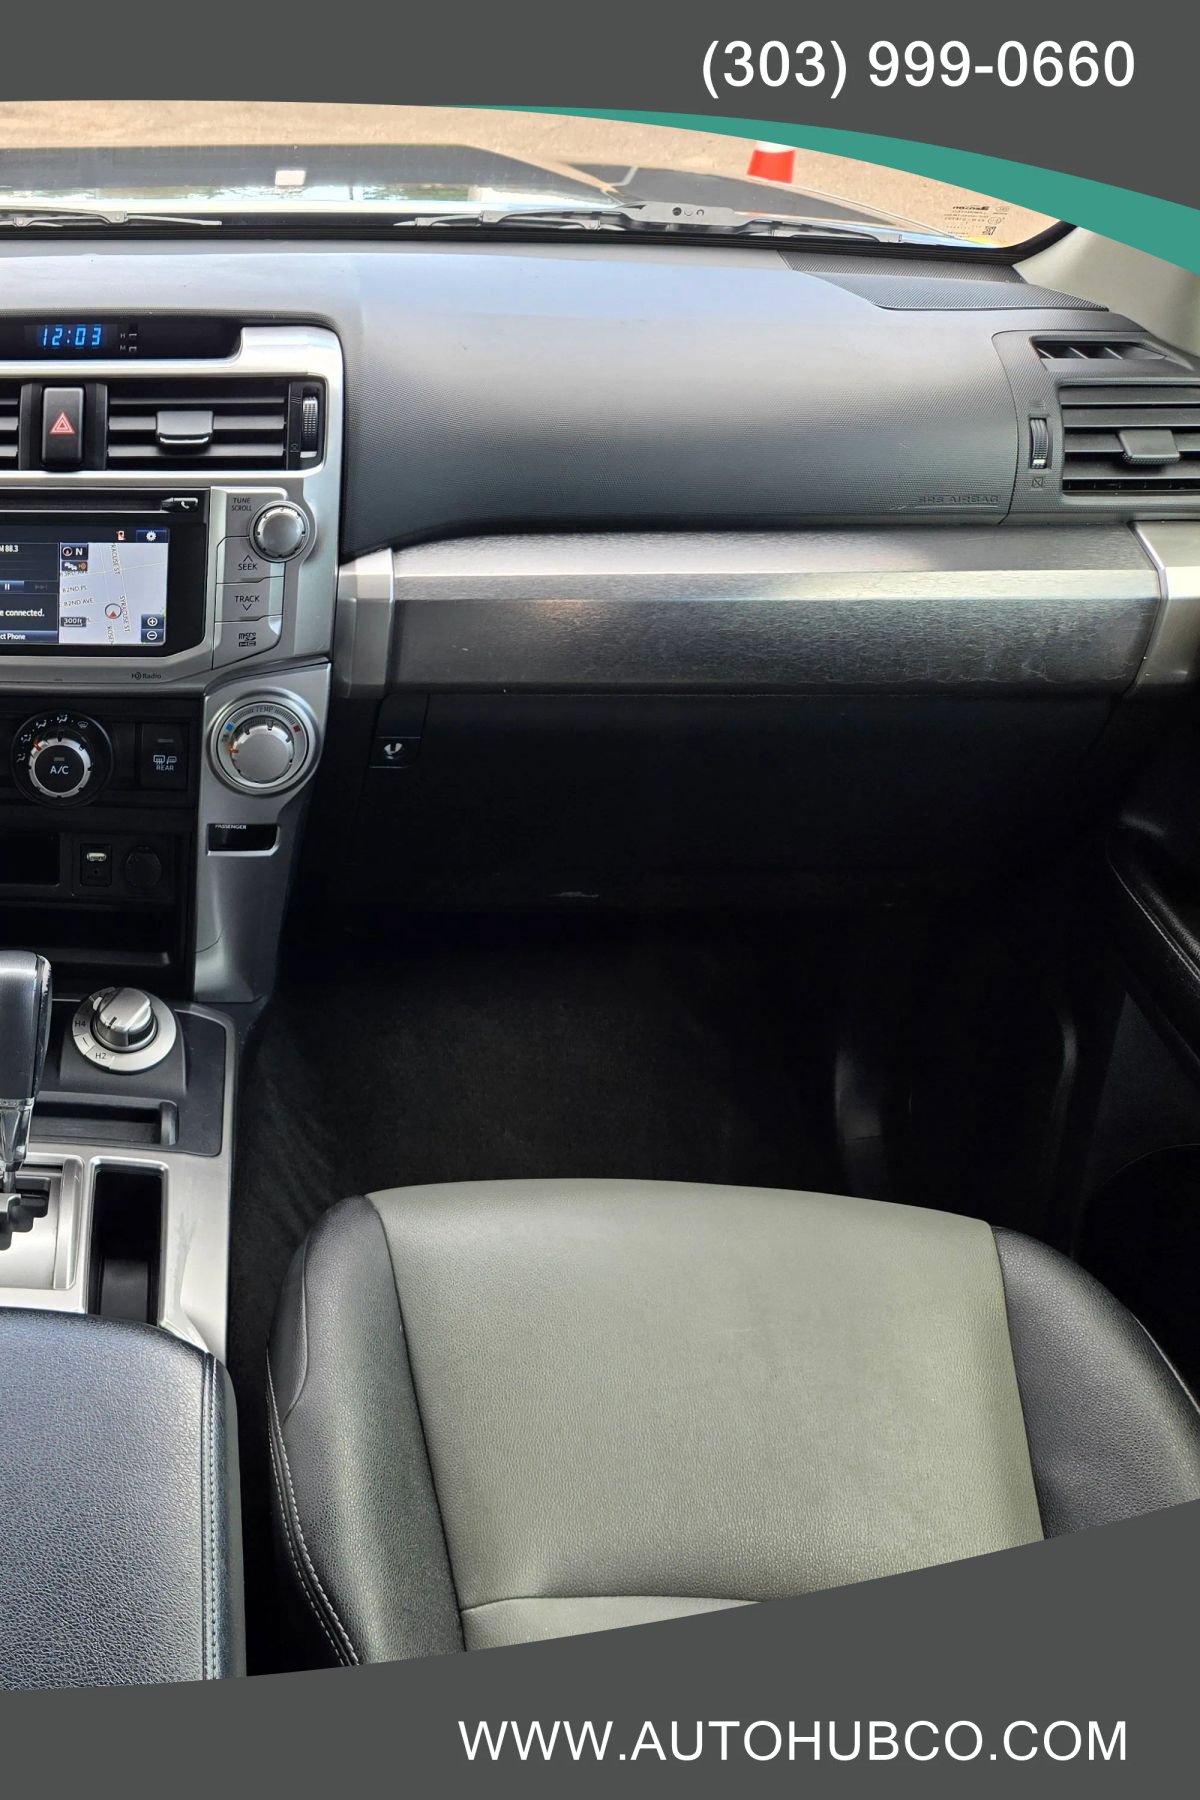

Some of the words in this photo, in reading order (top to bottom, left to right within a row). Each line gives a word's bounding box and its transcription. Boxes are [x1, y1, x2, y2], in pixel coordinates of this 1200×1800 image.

[43, 327, 101, 346] 12:03
[5, 545, 19, 553] 88.3
[75, 548, 83, 556] N
[238, 563, 258, 571] SEEK
[5, 608, 45, 617] connected.
[50, 765, 69, 775] A/C
